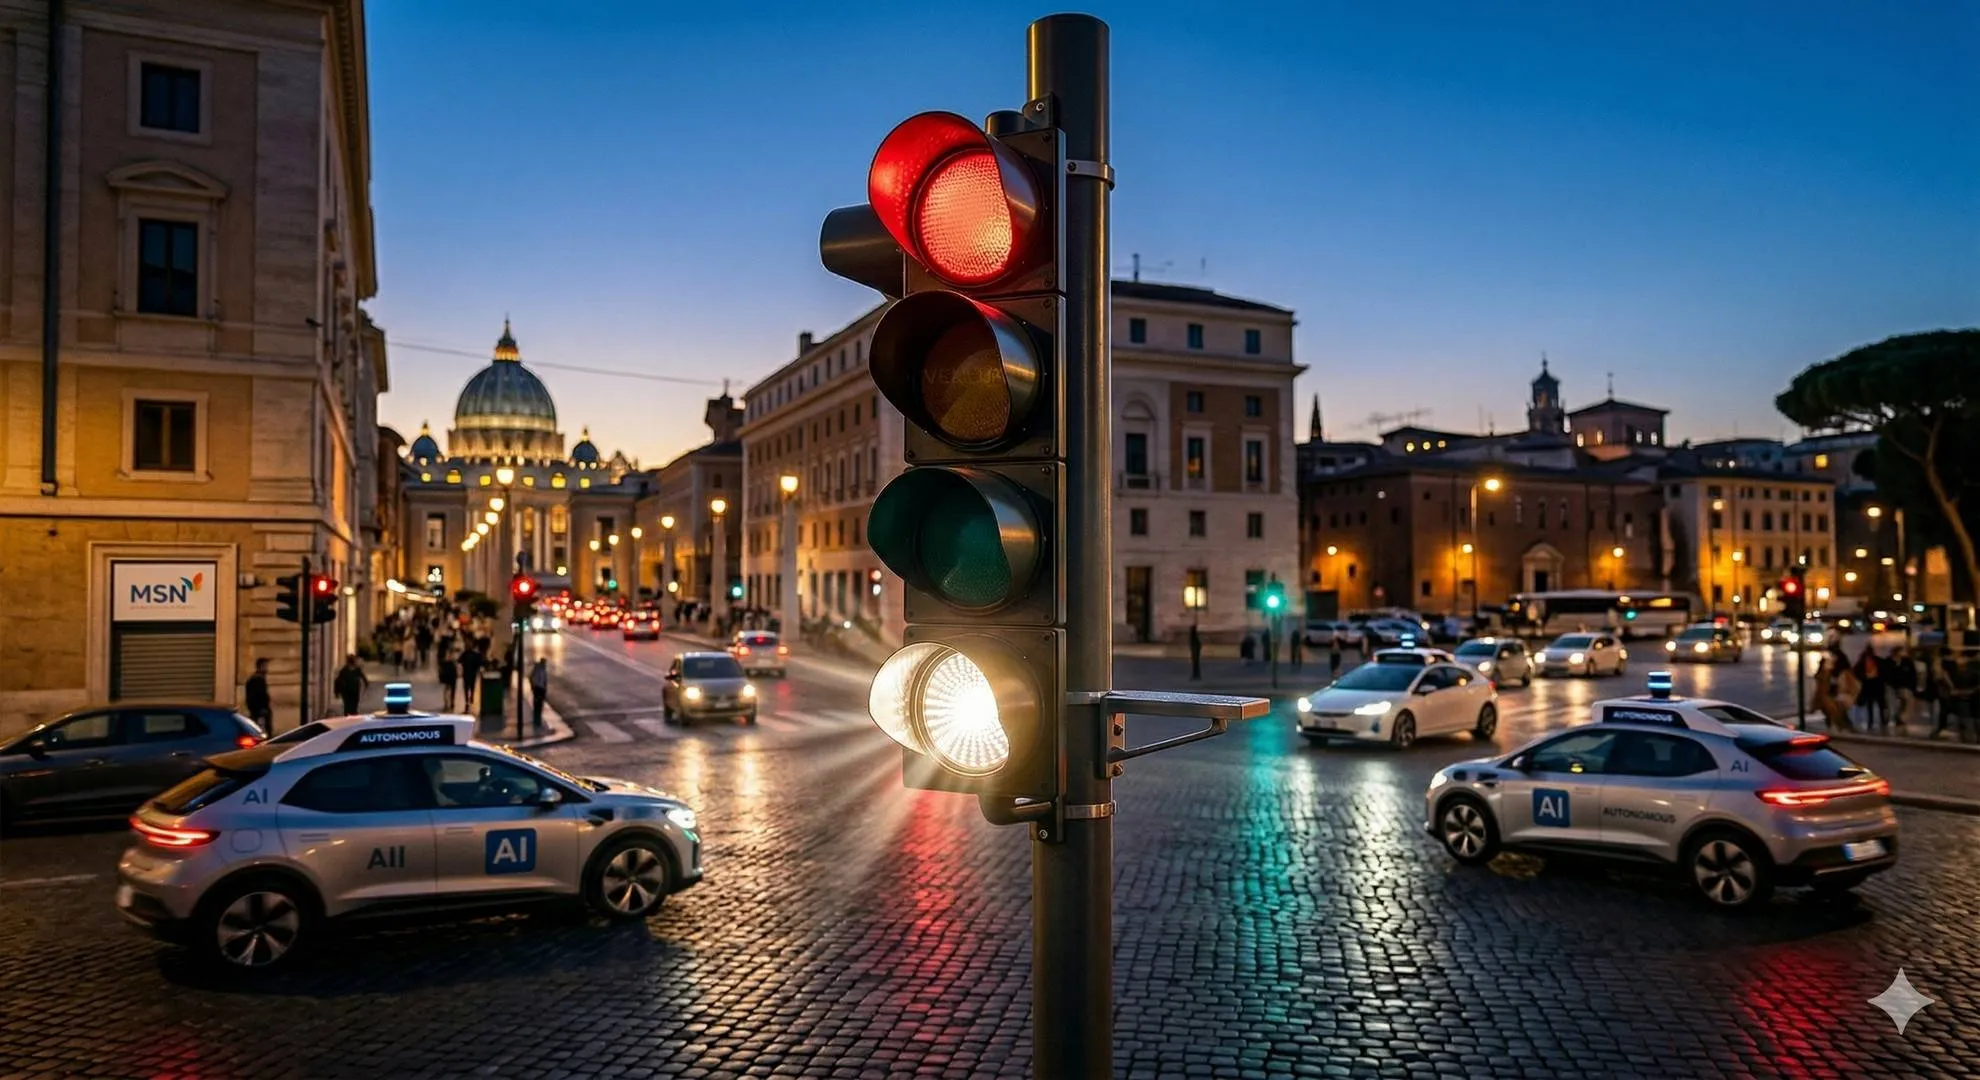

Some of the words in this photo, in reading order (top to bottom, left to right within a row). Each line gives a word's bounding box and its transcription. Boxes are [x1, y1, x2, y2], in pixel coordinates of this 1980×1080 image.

[130, 584, 187, 604] MSN
[360, 730, 441, 743] AUTONOMOUS
[1730, 759, 1749, 773] AI
[242, 787, 269, 805] AI
[1538, 795, 1564, 819] AI
[1602, 806, 1677, 825] AUTONOMOUS
[492, 835, 528, 865] AI
